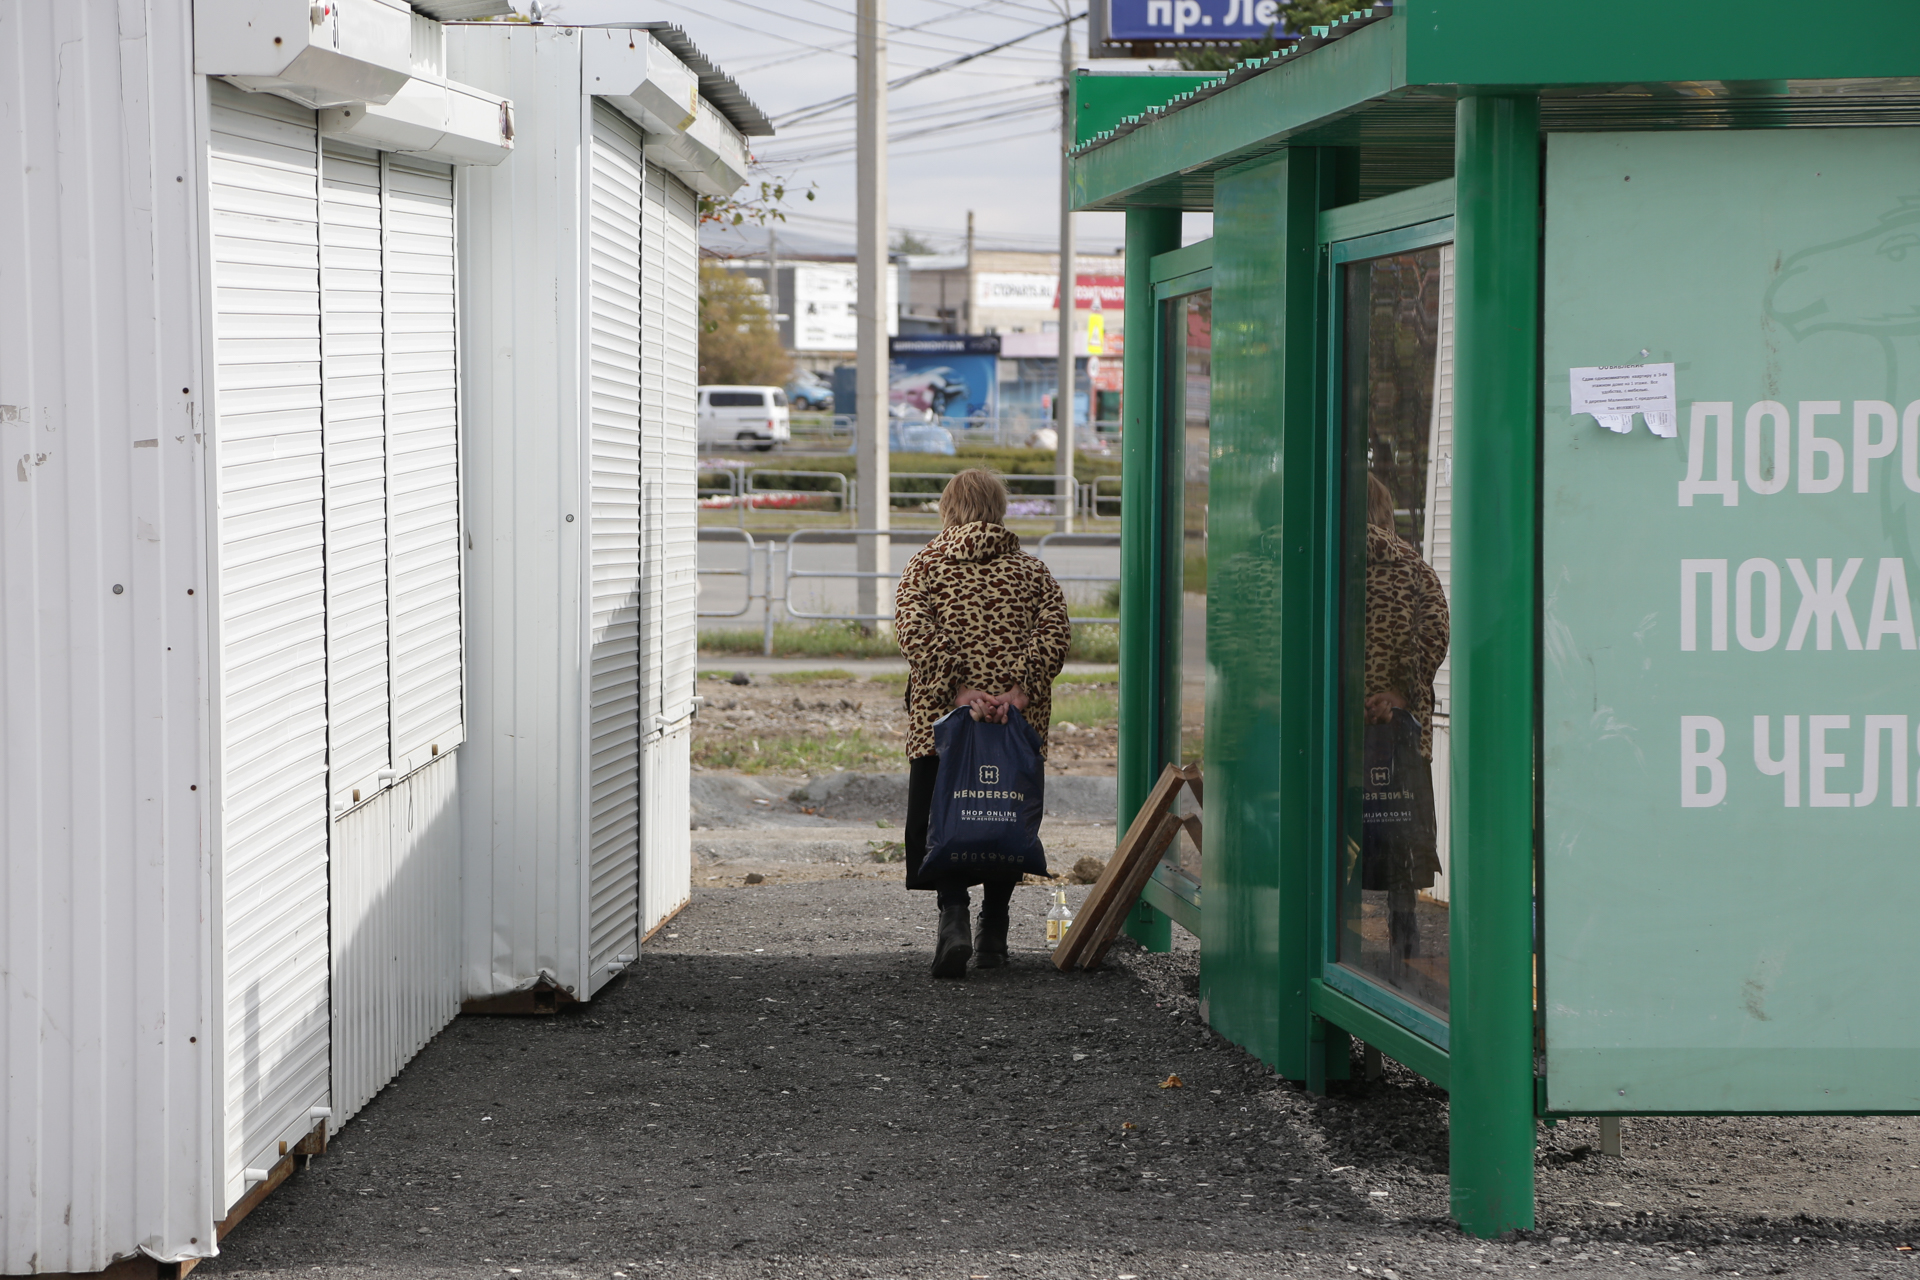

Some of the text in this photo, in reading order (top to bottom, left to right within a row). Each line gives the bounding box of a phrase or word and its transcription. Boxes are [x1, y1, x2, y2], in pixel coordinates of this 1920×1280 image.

[1147, 0, 1288, 34] пр. Ле
[1680, 557, 1920, 652] ПОЖА
[984, 771, 994, 779] H
[1681, 715, 1920, 808] В ЧЕЛ
[953, 790, 1024, 801] HENDERSON
